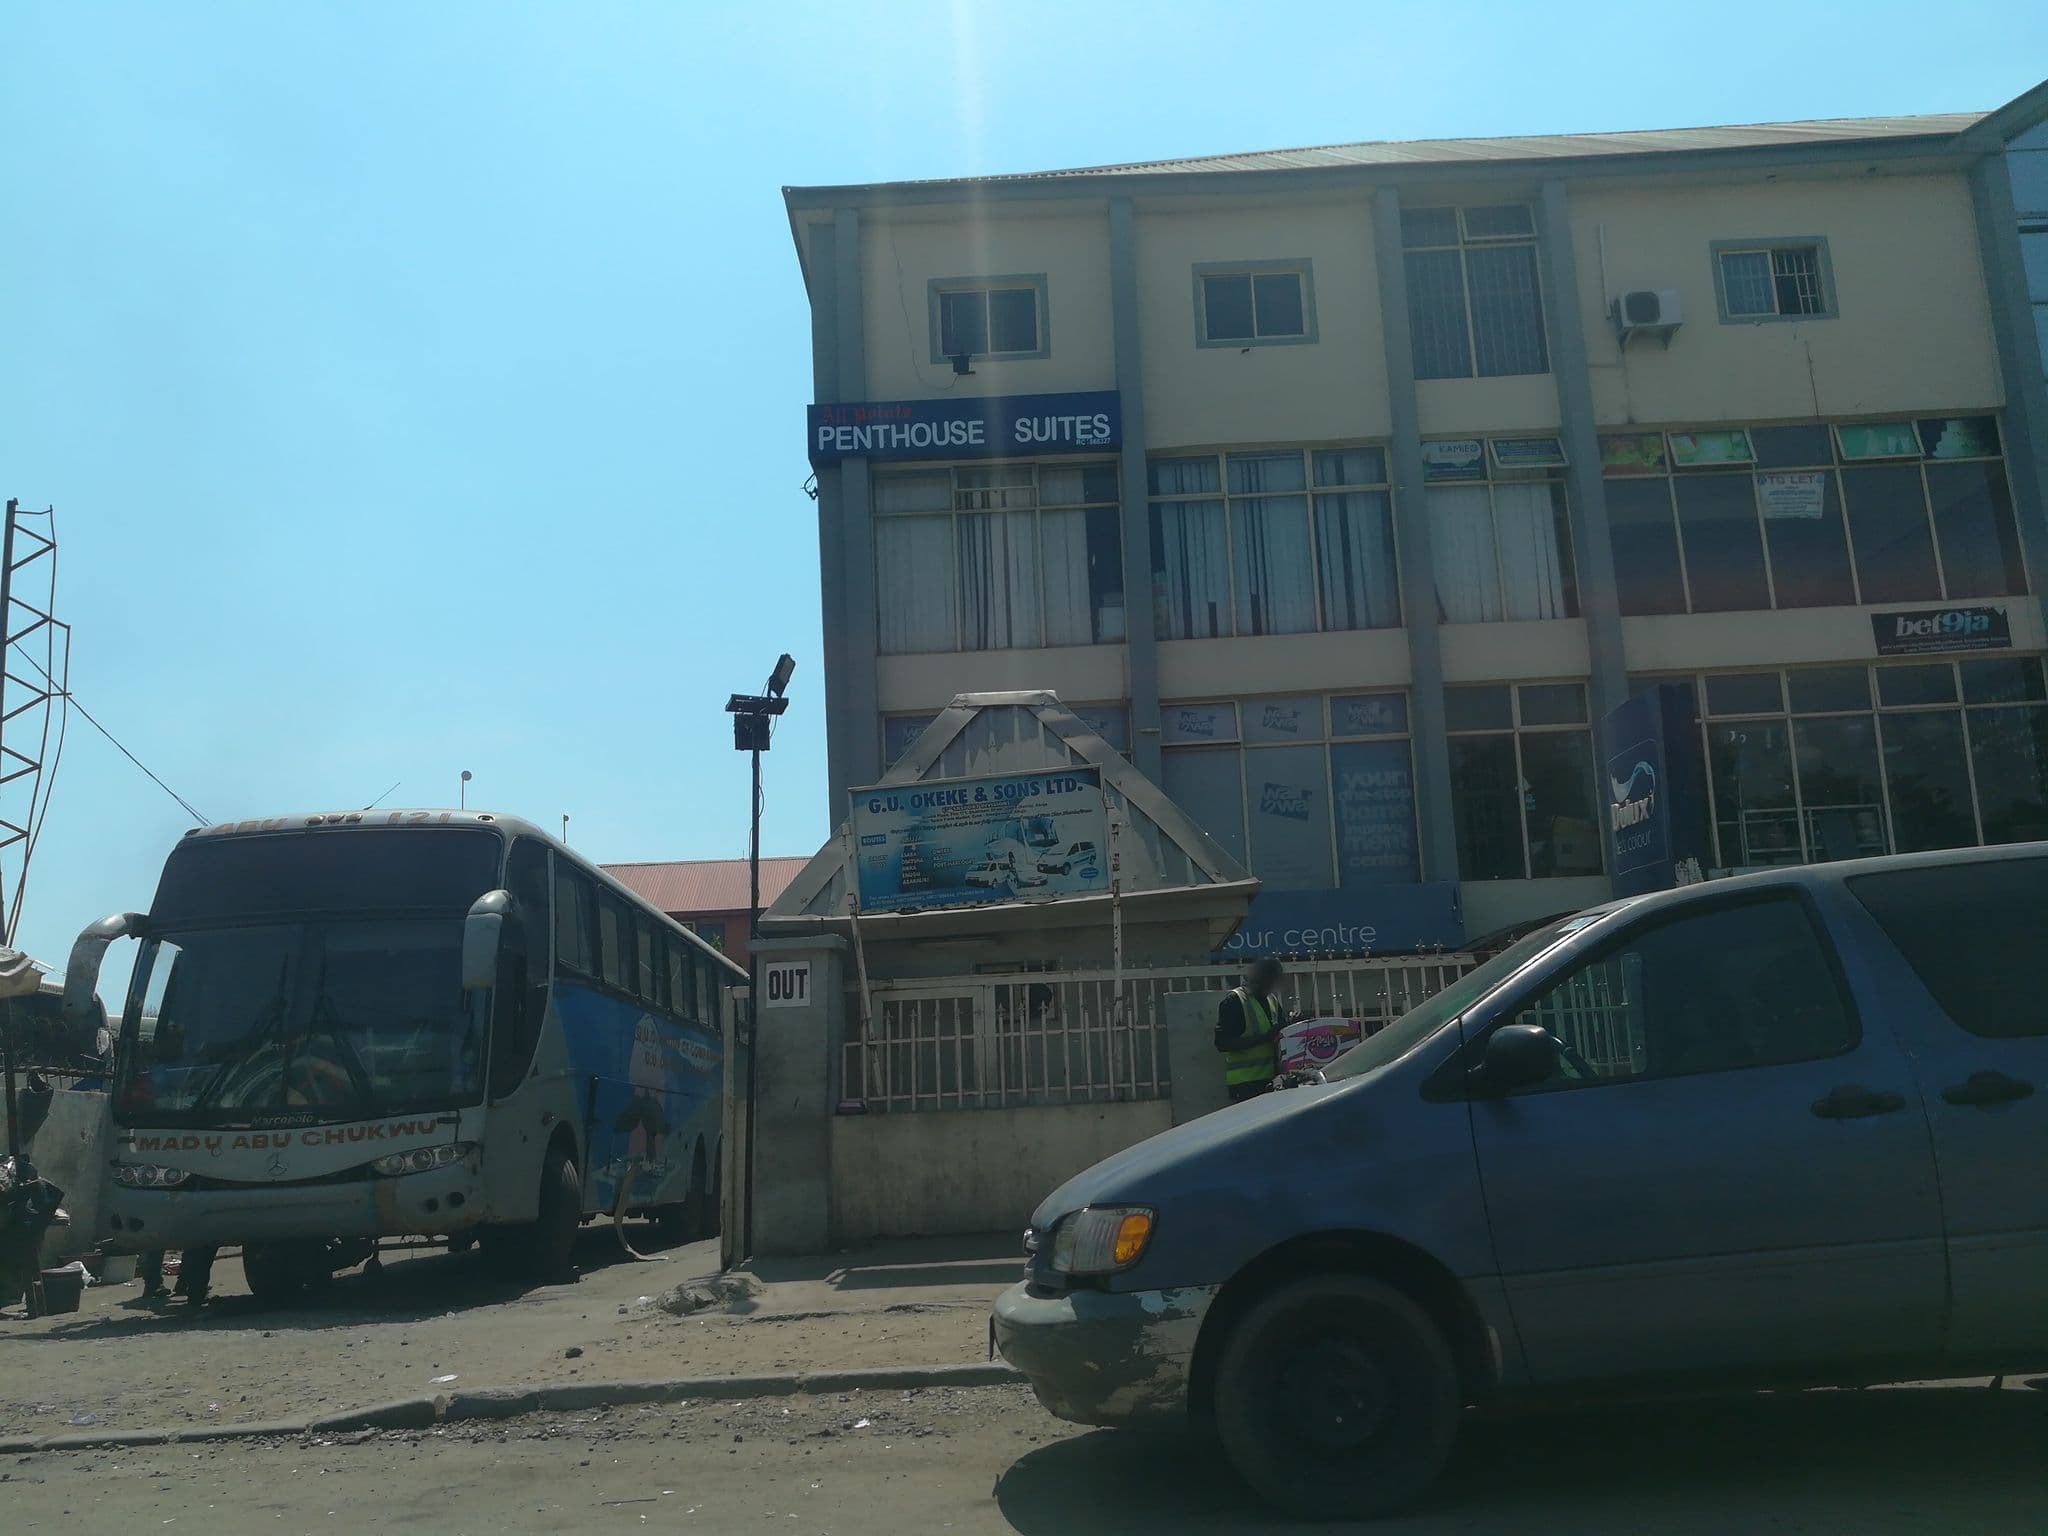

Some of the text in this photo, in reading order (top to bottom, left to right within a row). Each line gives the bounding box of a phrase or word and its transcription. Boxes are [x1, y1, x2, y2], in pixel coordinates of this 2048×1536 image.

[818, 413, 1111, 451] PENTHOUSE SUITES
[1896, 611, 1989, 637] bet9ja
[868, 777, 1084, 814] G.U. OKEKE & SONS LTD.
[1284, 922, 1377, 947] centre
[768, 968, 808, 1000] OUT
[139, 1117, 438, 1153] MADU ABU CHUKWU
